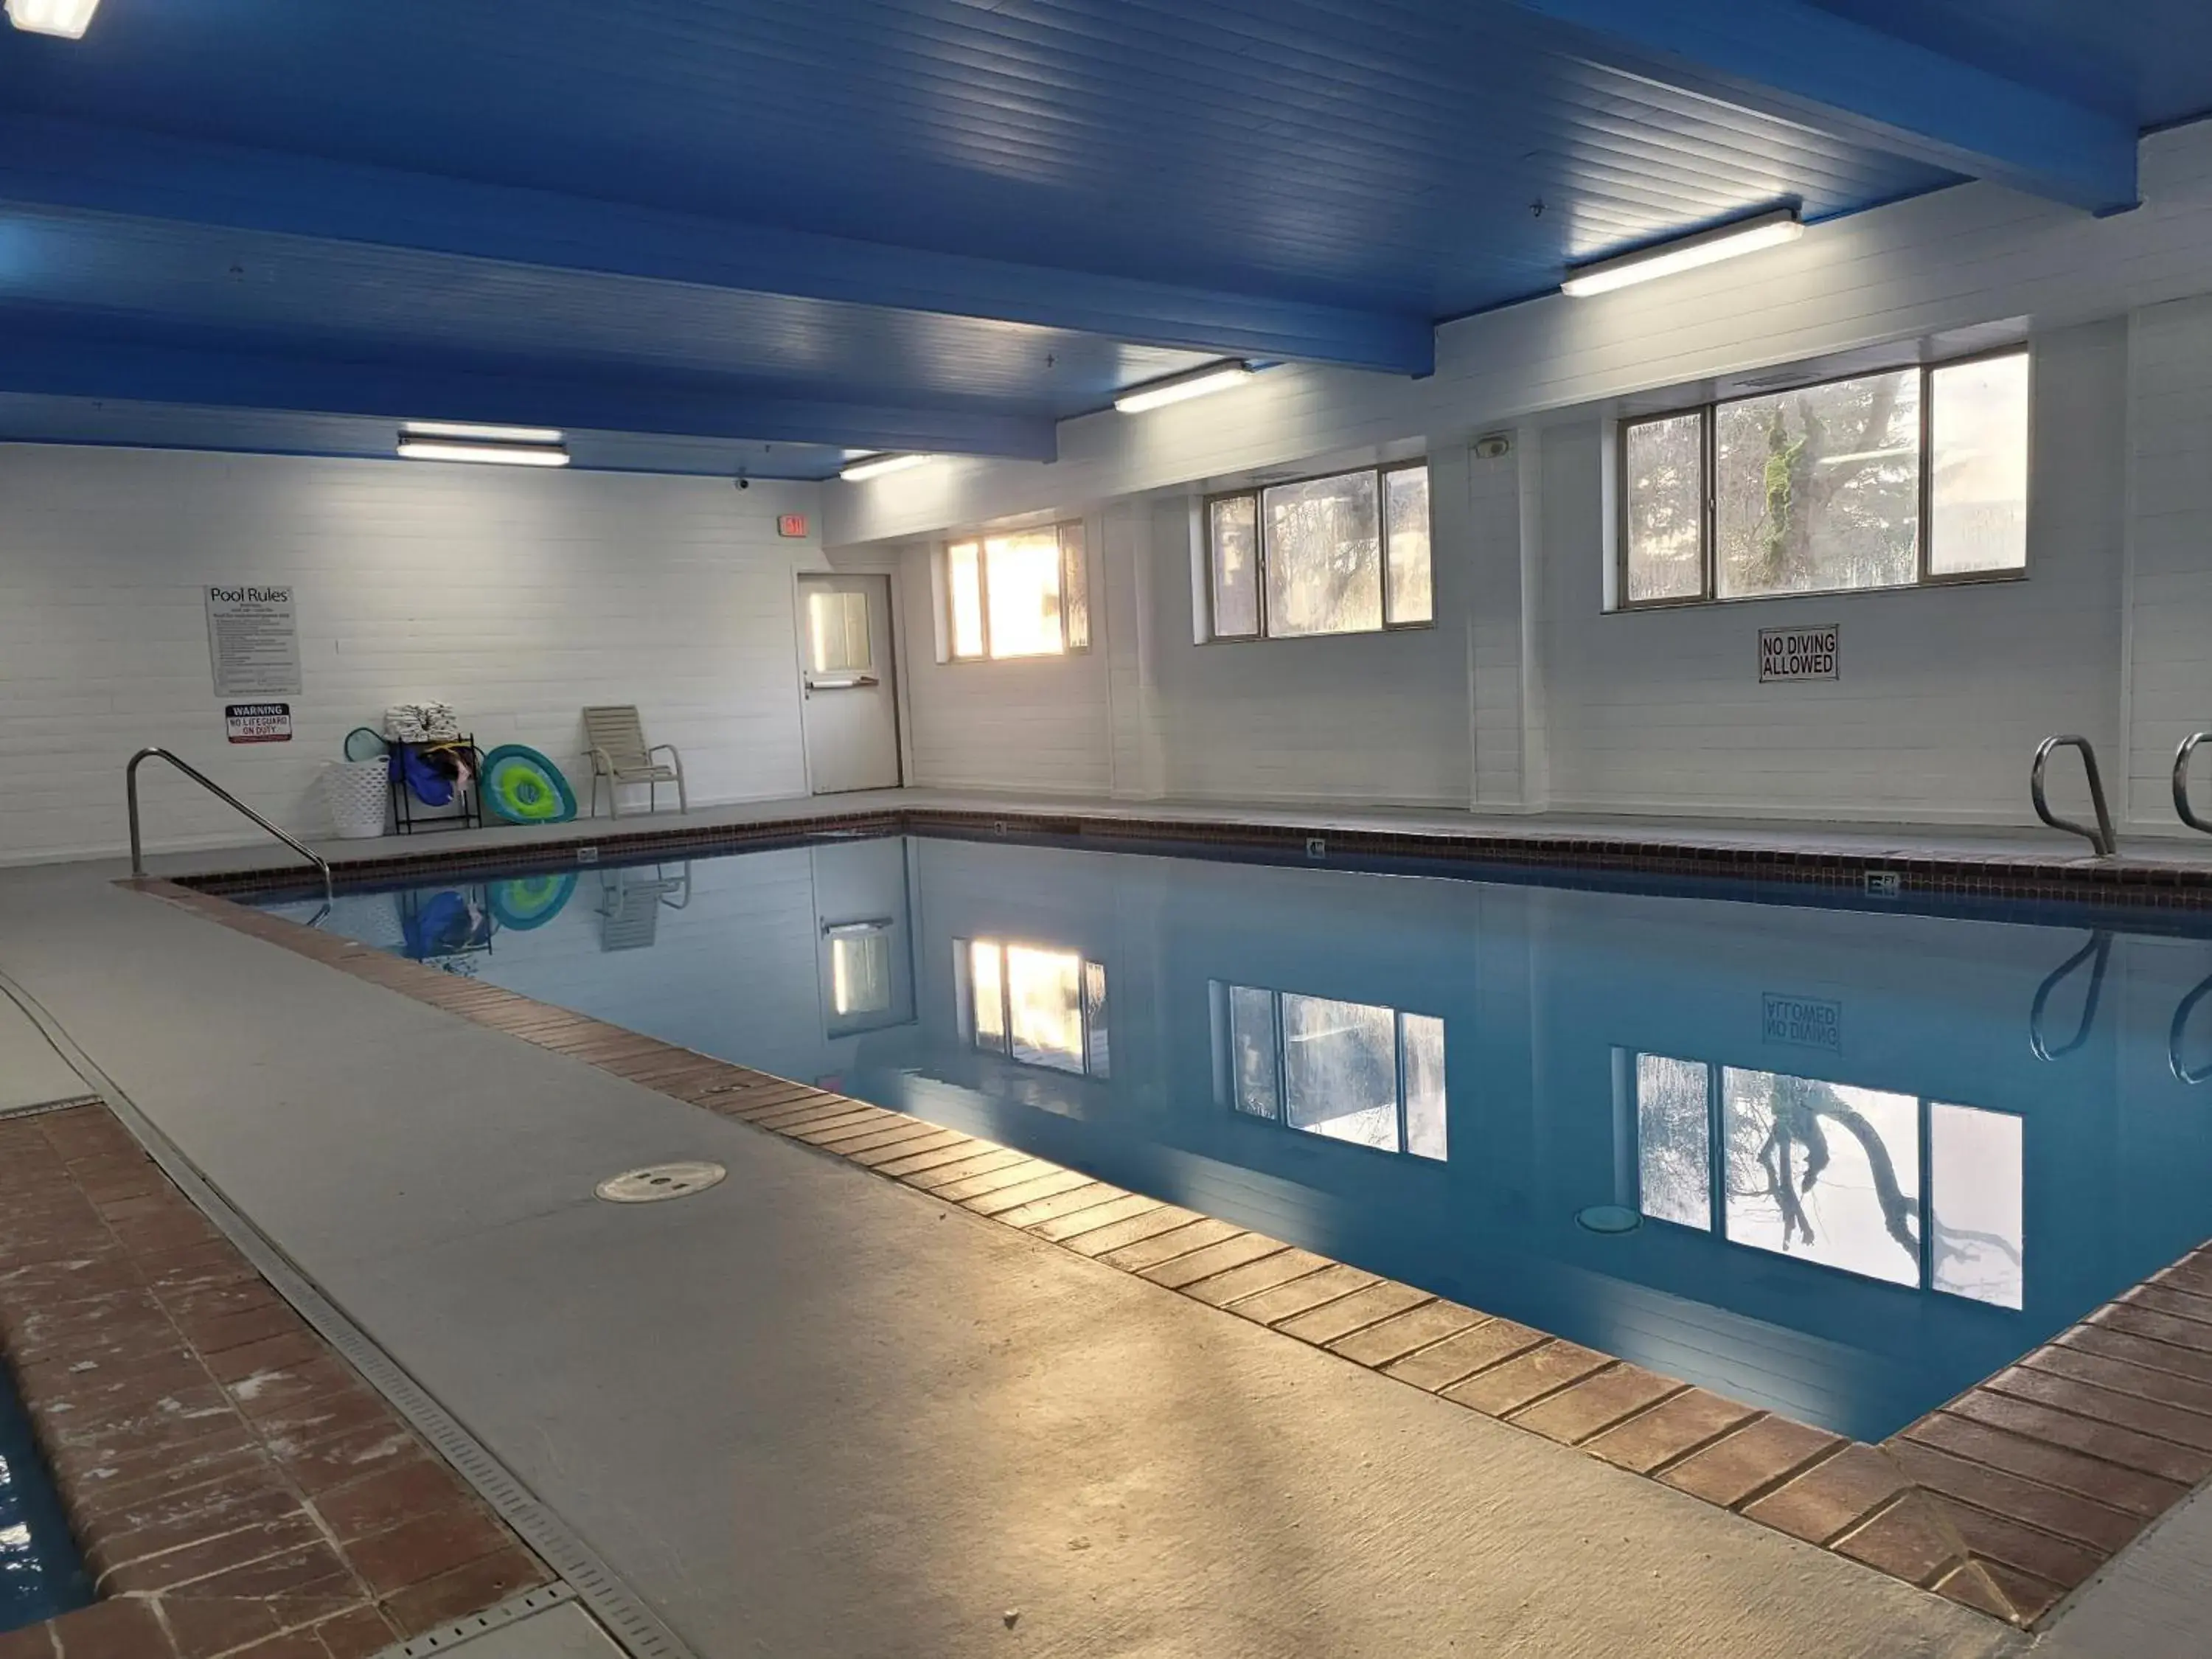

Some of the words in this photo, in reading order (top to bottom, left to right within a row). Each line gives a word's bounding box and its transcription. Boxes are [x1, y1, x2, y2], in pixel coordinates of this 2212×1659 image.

[211, 587, 244, 602] Pool
[248, 587, 288, 602] Rules
[1764, 637, 1783, 655] NO
[1787, 634, 1835, 654] DIVING
[1764, 654, 1833, 675] ALLOWED
[234, 705, 282, 715] WARNING
[243, 716, 286, 726] LIFEGUARD
[257, 726, 276, 734] DUTY
